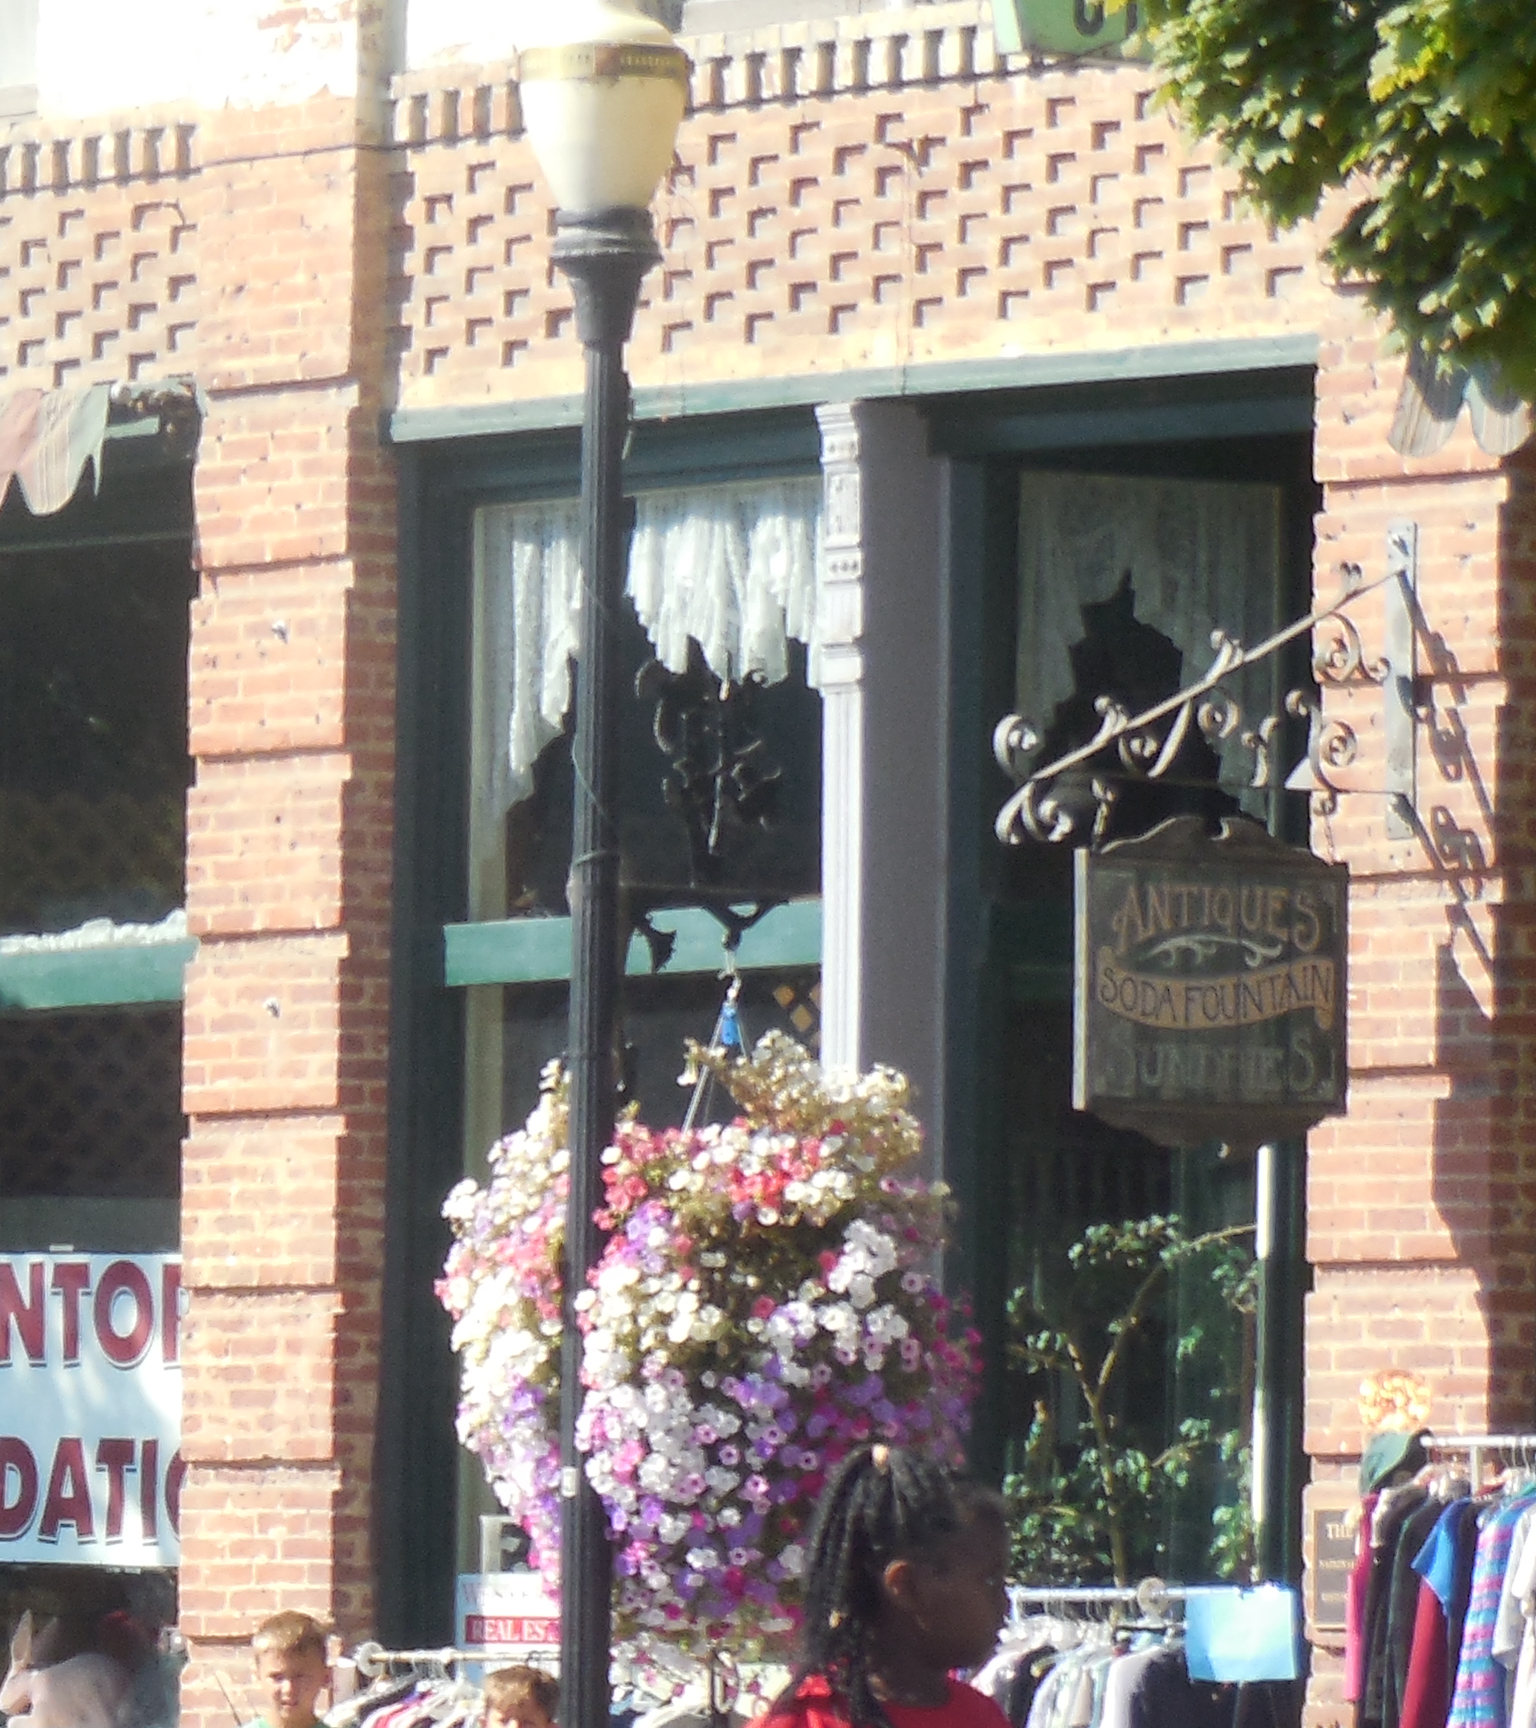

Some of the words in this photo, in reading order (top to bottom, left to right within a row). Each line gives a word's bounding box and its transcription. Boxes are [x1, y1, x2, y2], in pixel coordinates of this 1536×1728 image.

[1112, 881, 1320, 955] ANTIQUES
[1100, 966, 1177, 1022] SODA
[1184, 963, 1331, 1022] FOUNTAIN
[472, 1619, 521, 1641] REAL
[524, 1619, 558, 1641] ES
